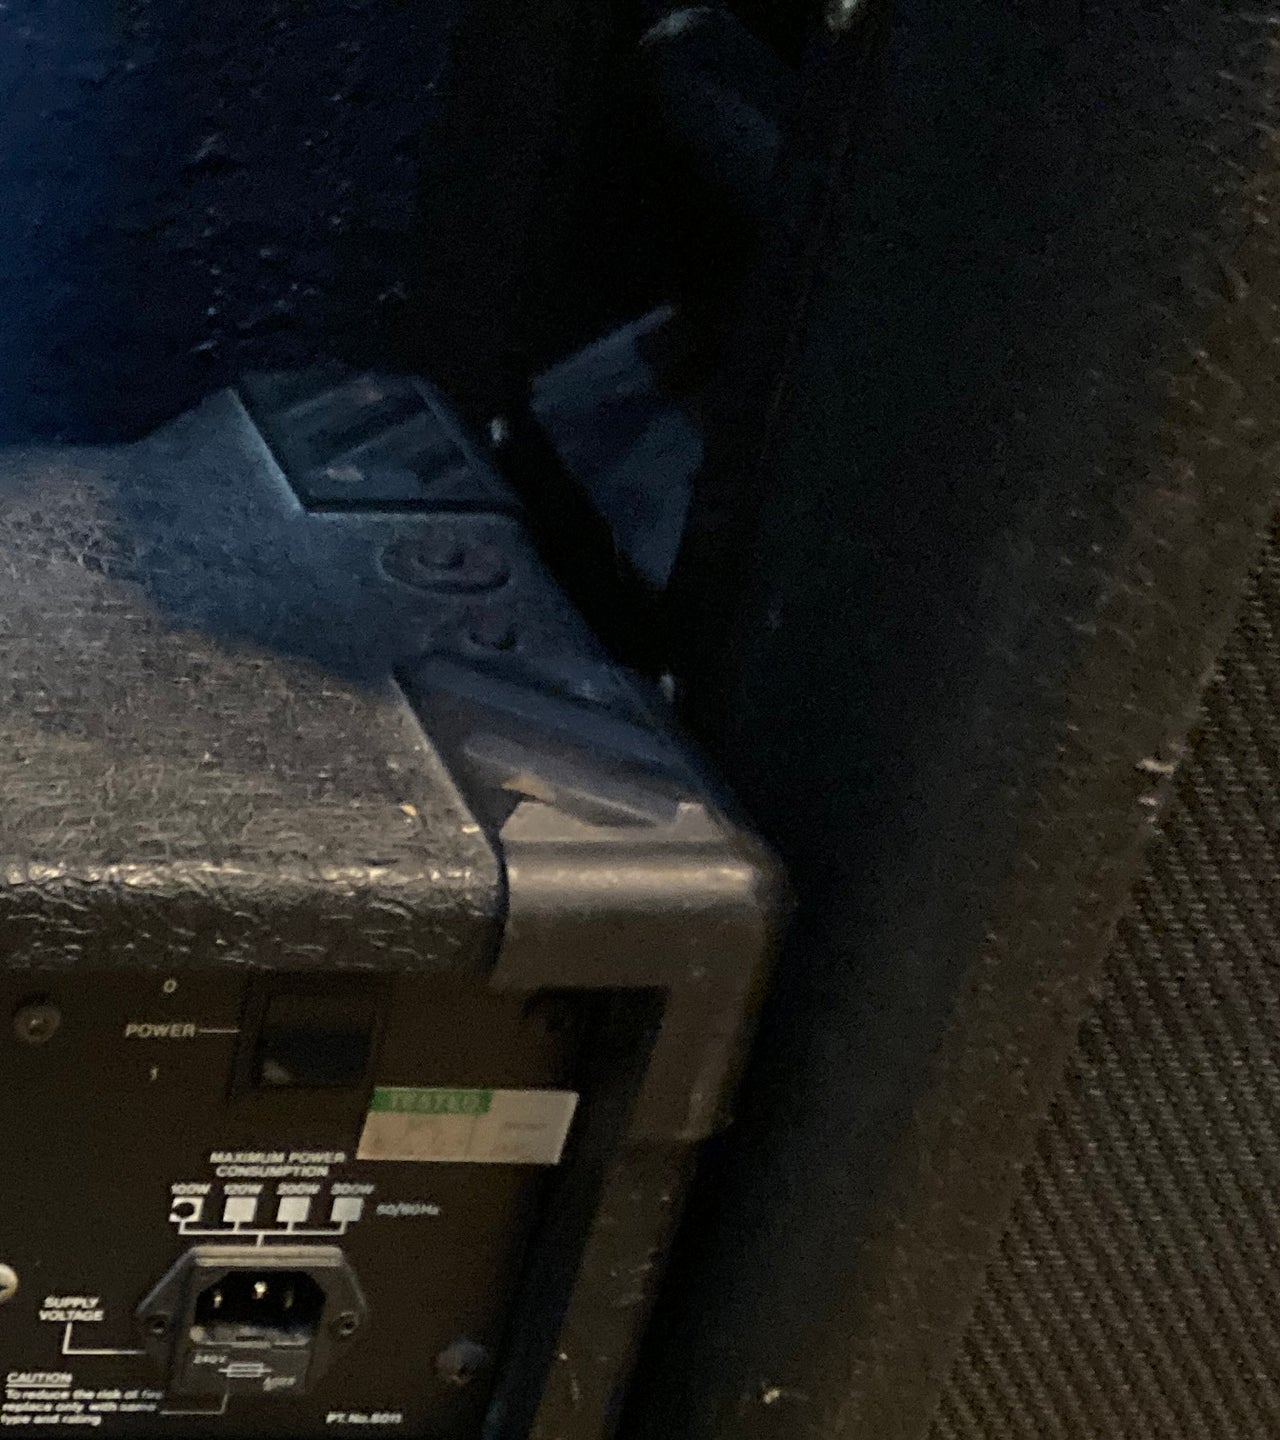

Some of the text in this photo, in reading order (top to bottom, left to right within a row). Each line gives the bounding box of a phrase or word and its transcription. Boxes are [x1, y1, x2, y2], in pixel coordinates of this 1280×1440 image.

[125, 1023, 196, 1038] POWER
[210, 1153, 345, 1164] MAXIMUM POWER
[215, 1166, 329, 1178] CONSUMPTION
[44, 1297, 99, 1308] SUPPLY
[40, 1309, 103, 1321] VOLTAGE
[7, 1373, 72, 1384] CAUTION
